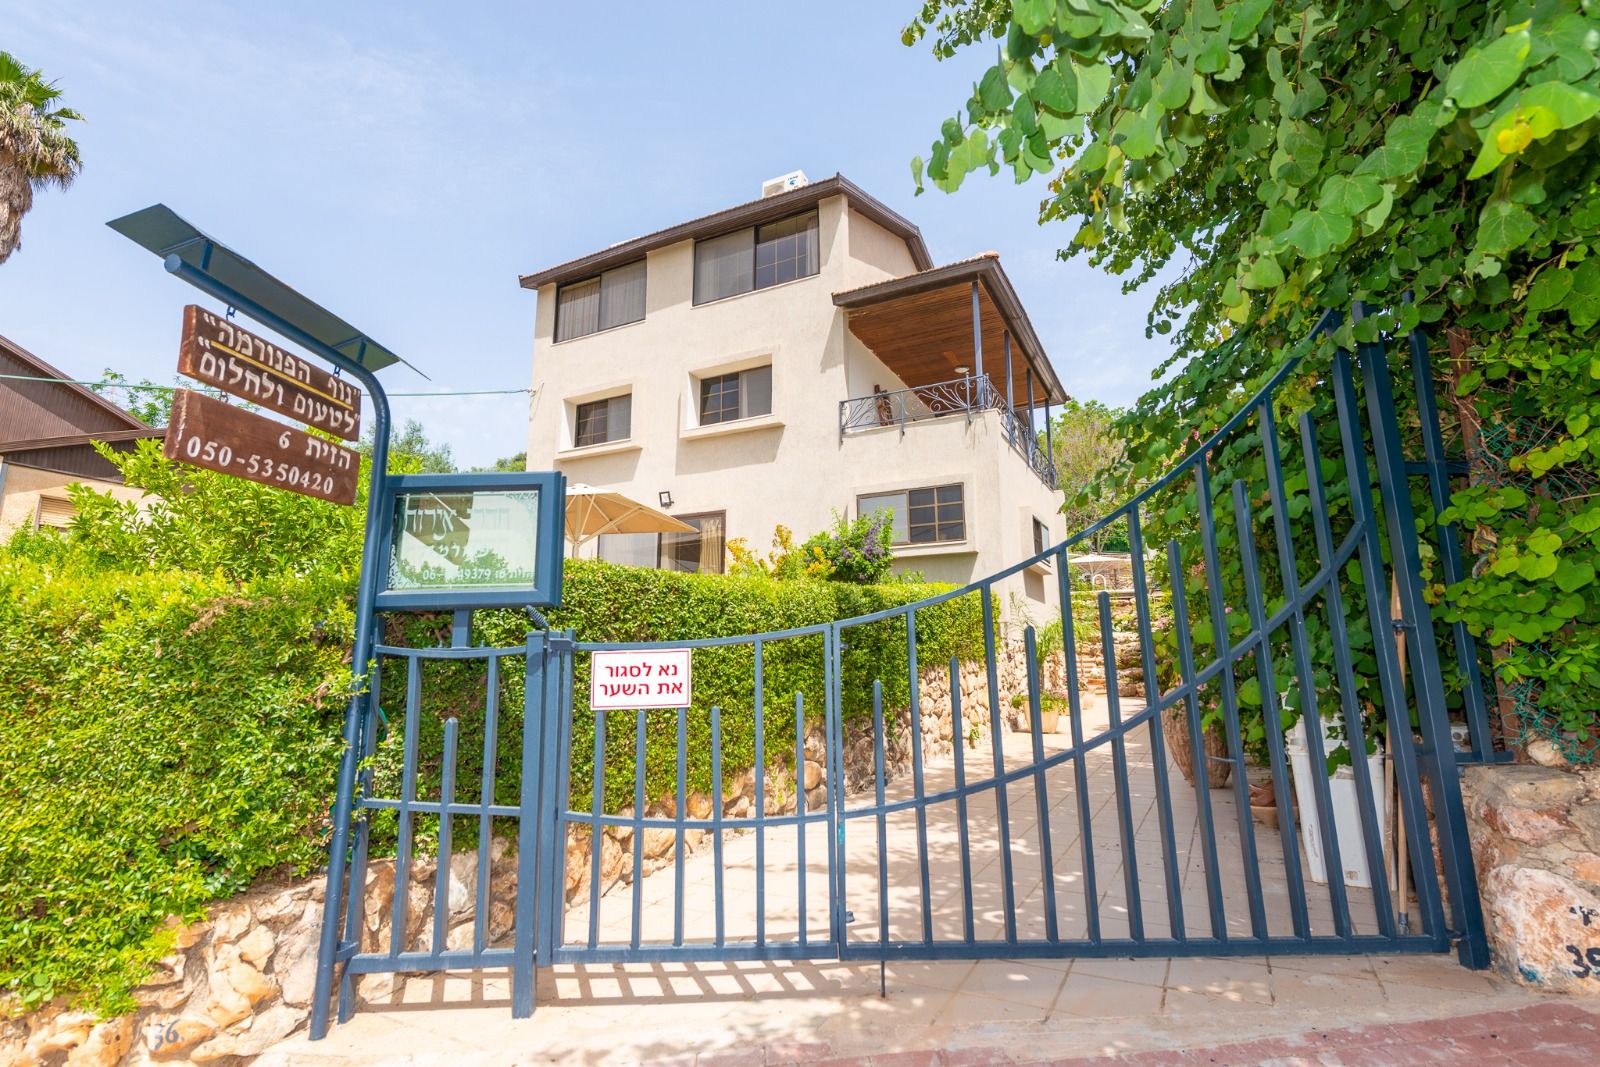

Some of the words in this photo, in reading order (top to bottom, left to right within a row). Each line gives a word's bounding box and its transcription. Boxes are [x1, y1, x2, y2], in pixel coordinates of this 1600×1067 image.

[279, 430, 292, 449] 6
[305, 436, 351, 470] הזית
[186, 436, 334, 494] 050-5350420
[605, 662, 652, 677] לסגור
[658, 664, 678, 677] נא
[600, 683, 650, 697] השער
[657, 682, 683, 695] את
